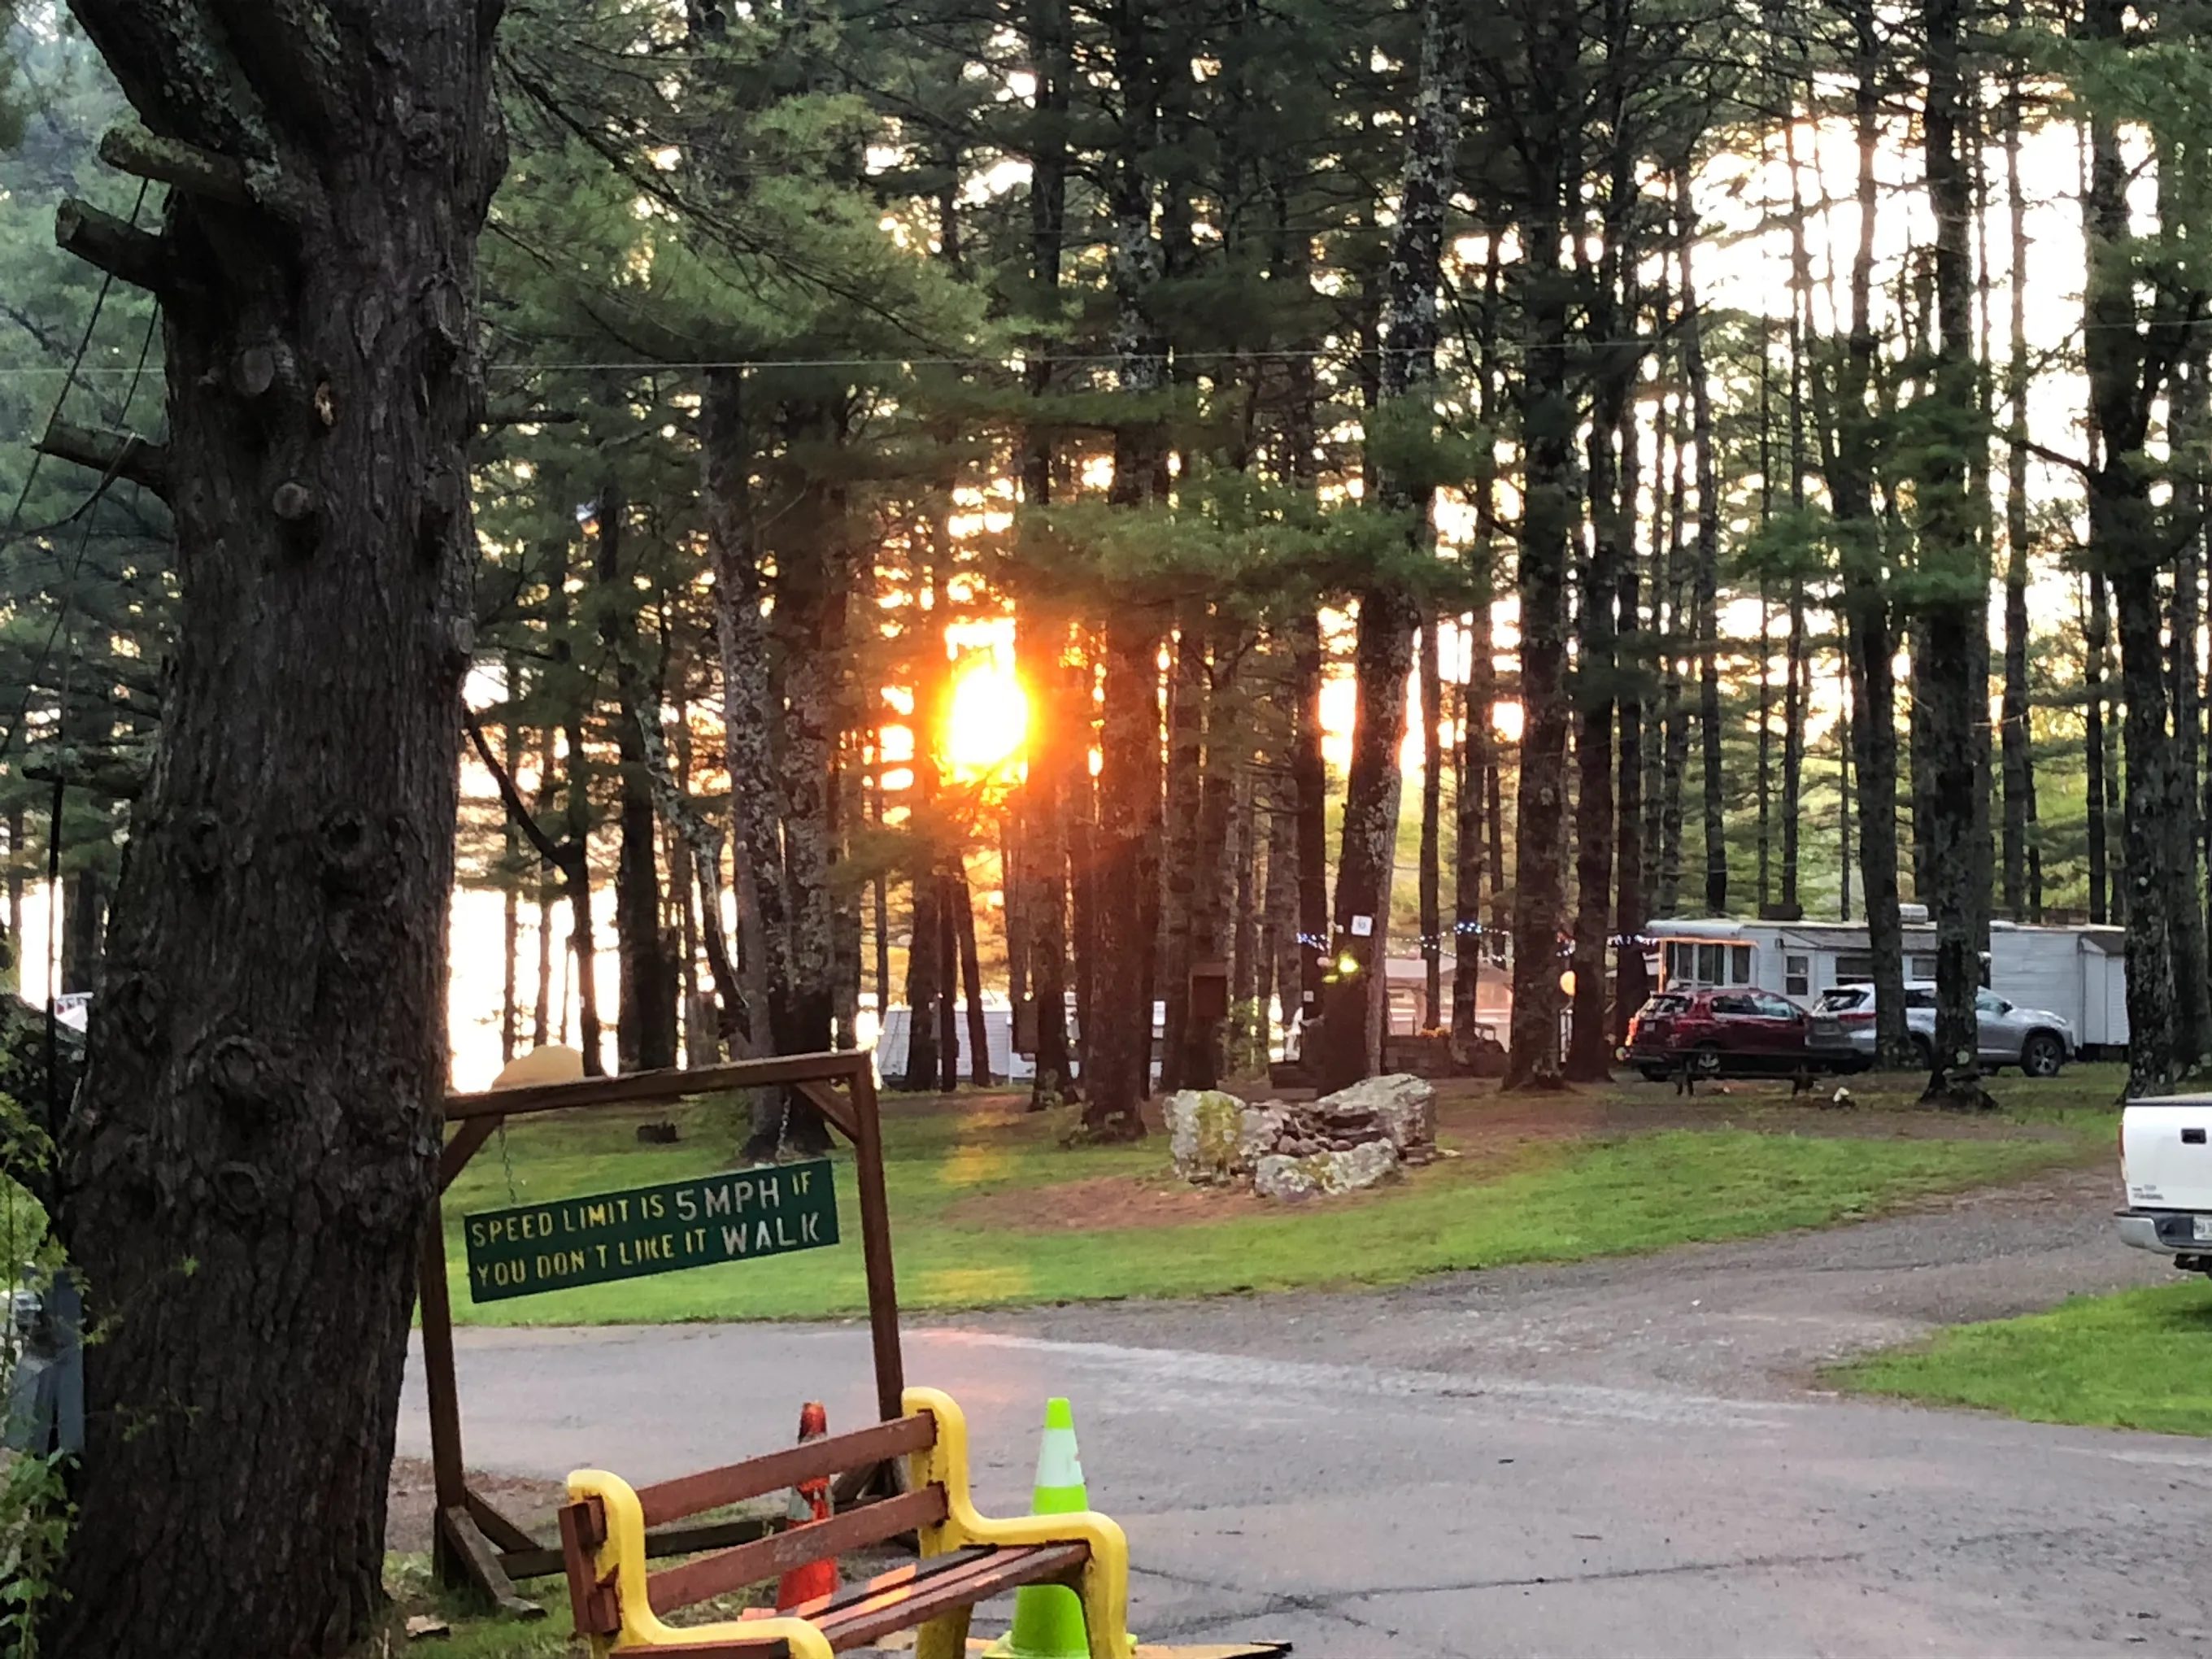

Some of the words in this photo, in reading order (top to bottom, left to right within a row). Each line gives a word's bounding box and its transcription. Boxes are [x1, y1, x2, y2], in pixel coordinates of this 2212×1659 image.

[472, 1211, 554, 1248] SPEED
[563, 1199, 629, 1232] LIMIT
[641, 1194, 665, 1220] IS
[792, 1171, 812, 1196] IF
[477, 1258, 527, 1287] YOU
[619, 1233, 675, 1265] LIKE
[685, 1228, 707, 1255] IT
[721, 1211, 821, 1256] WALK
